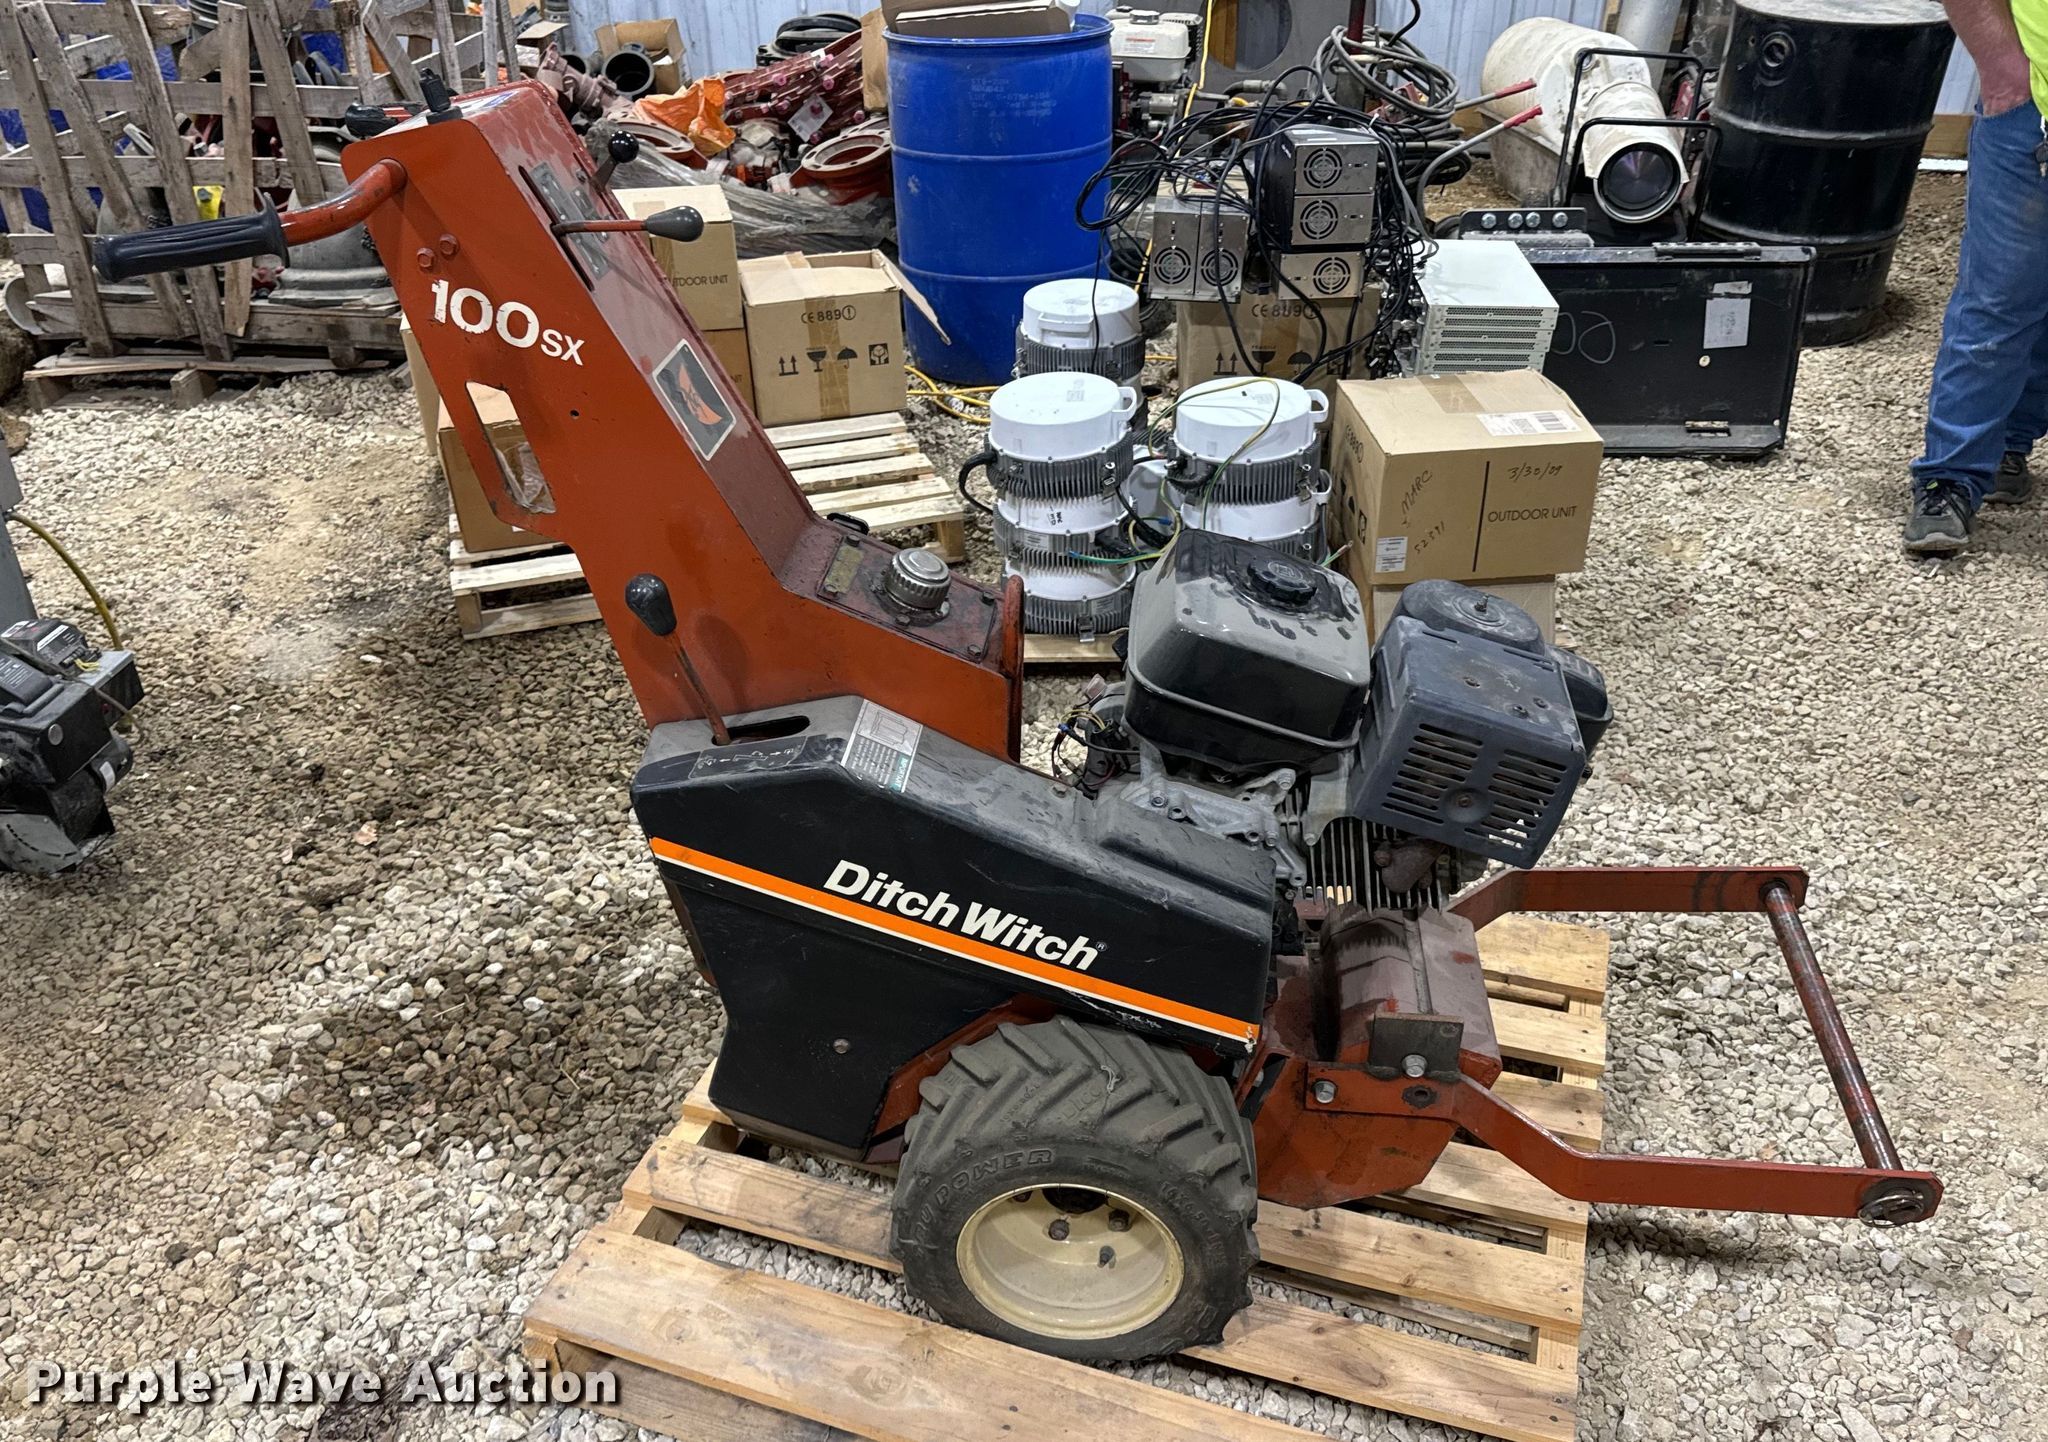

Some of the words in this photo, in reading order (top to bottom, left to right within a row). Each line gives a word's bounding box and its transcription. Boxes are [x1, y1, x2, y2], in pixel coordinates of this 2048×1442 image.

[710, 274, 728, 285] UNIT
[817, 309, 842, 322] 889
[1488, 508, 1548, 523] OUTDOOR
[1551, 505, 1578, 519] UNIT
[823, 859, 960, 928] Ditch
[960, 901, 1099, 971] Witch
[936, 1149, 1052, 1206] POWER
